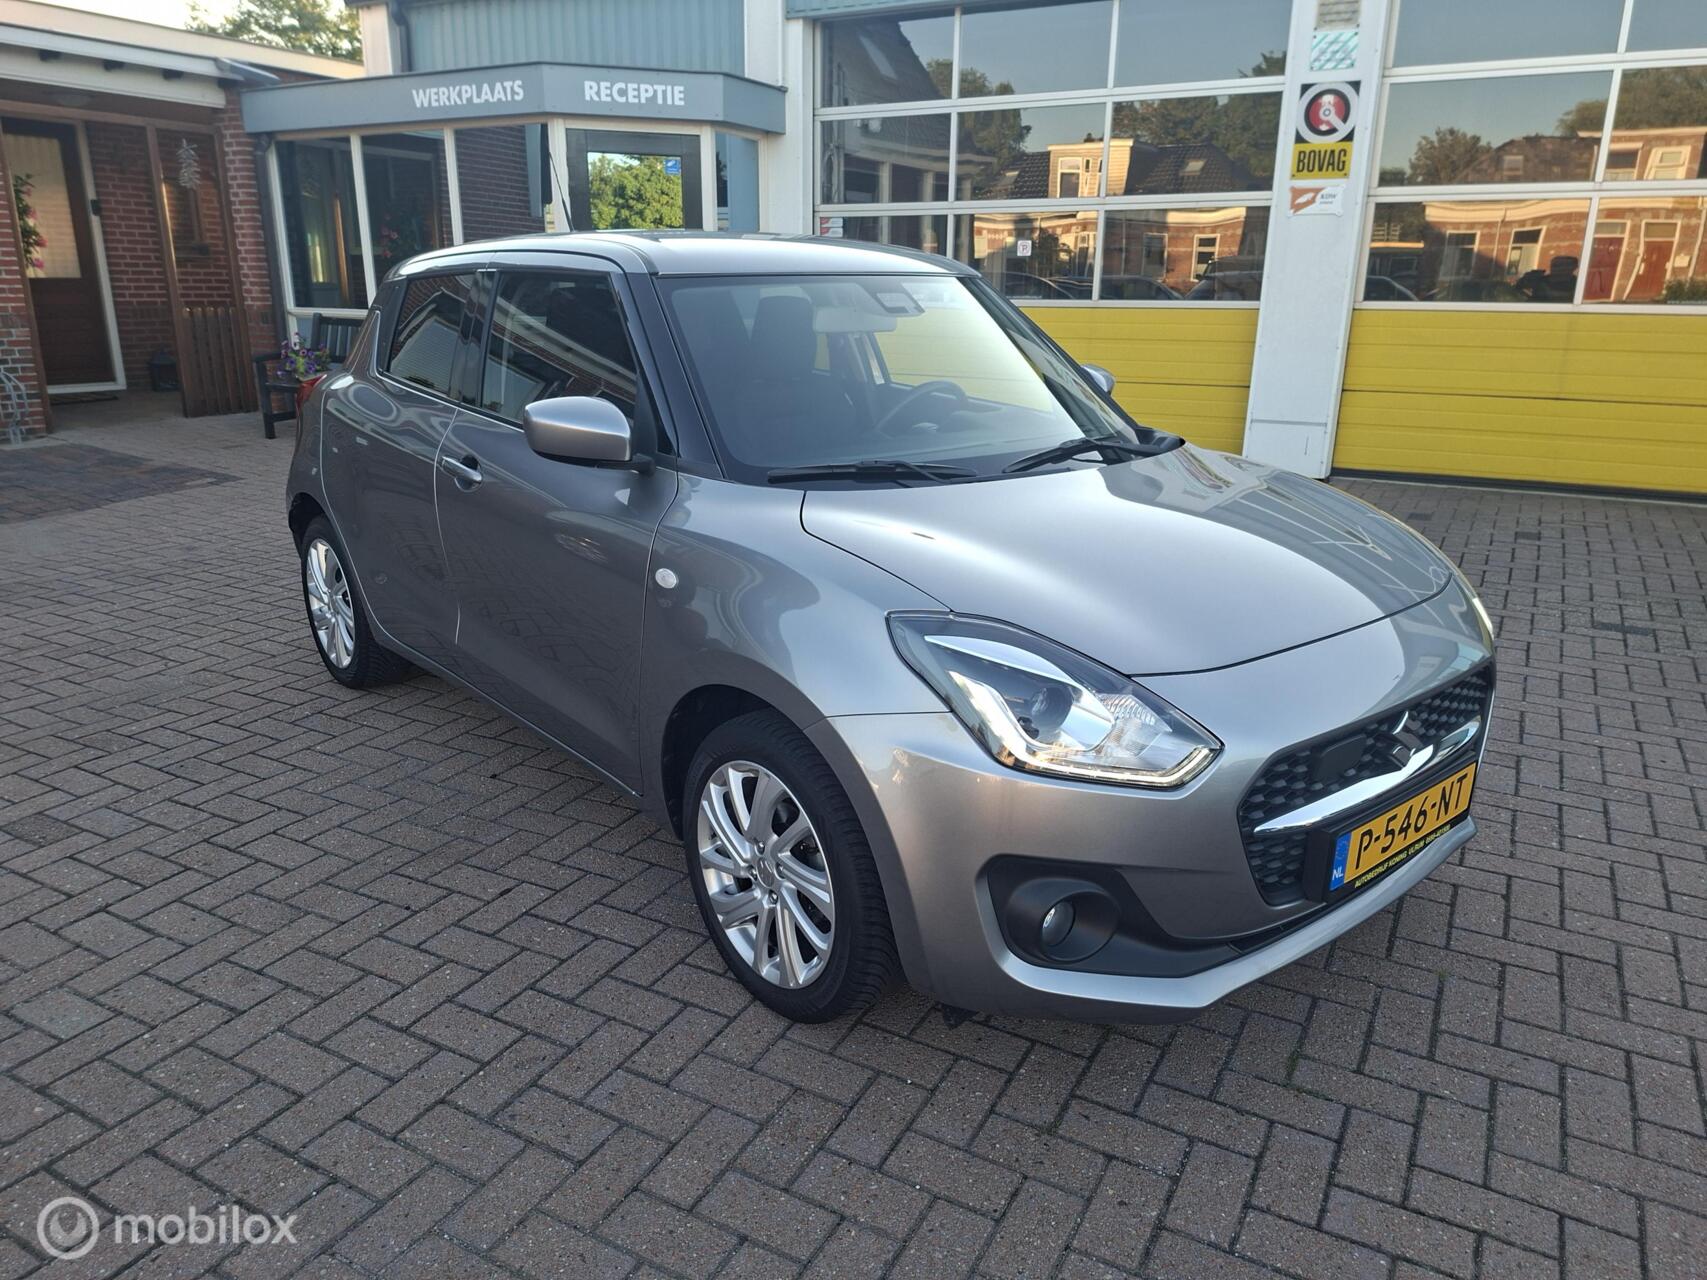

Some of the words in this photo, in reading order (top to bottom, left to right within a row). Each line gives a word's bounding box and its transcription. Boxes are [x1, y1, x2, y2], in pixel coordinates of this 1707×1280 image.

[412, 80, 525, 108] WERKPLAATS
[583, 80, 685, 106] RECEPTIE
[1296, 148, 1347, 173] BOVAG
[1355, 772, 1468, 870] P-546-NT
[1332, 867, 1344, 881] NL
